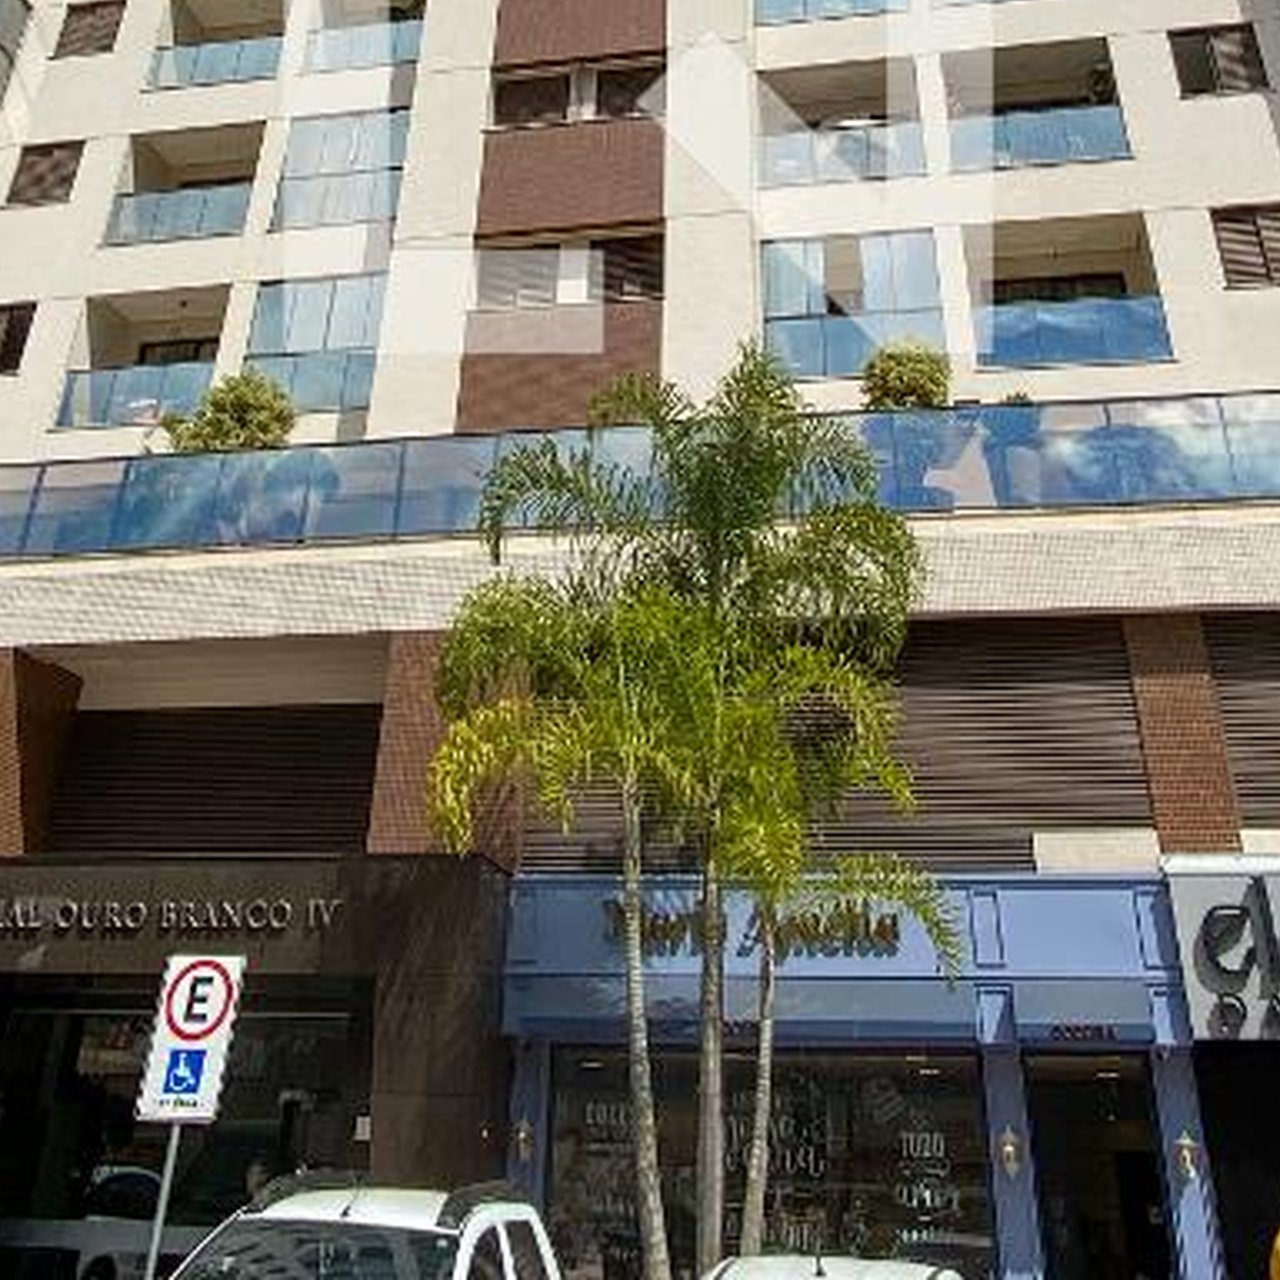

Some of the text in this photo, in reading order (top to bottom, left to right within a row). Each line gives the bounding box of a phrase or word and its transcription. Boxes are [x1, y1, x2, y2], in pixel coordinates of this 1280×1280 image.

[56, 900, 148, 928] OURO
[160, 898, 292, 929] BRANCO
[307, 898, 345, 927] IV
[184, 976, 215, 1022] E
